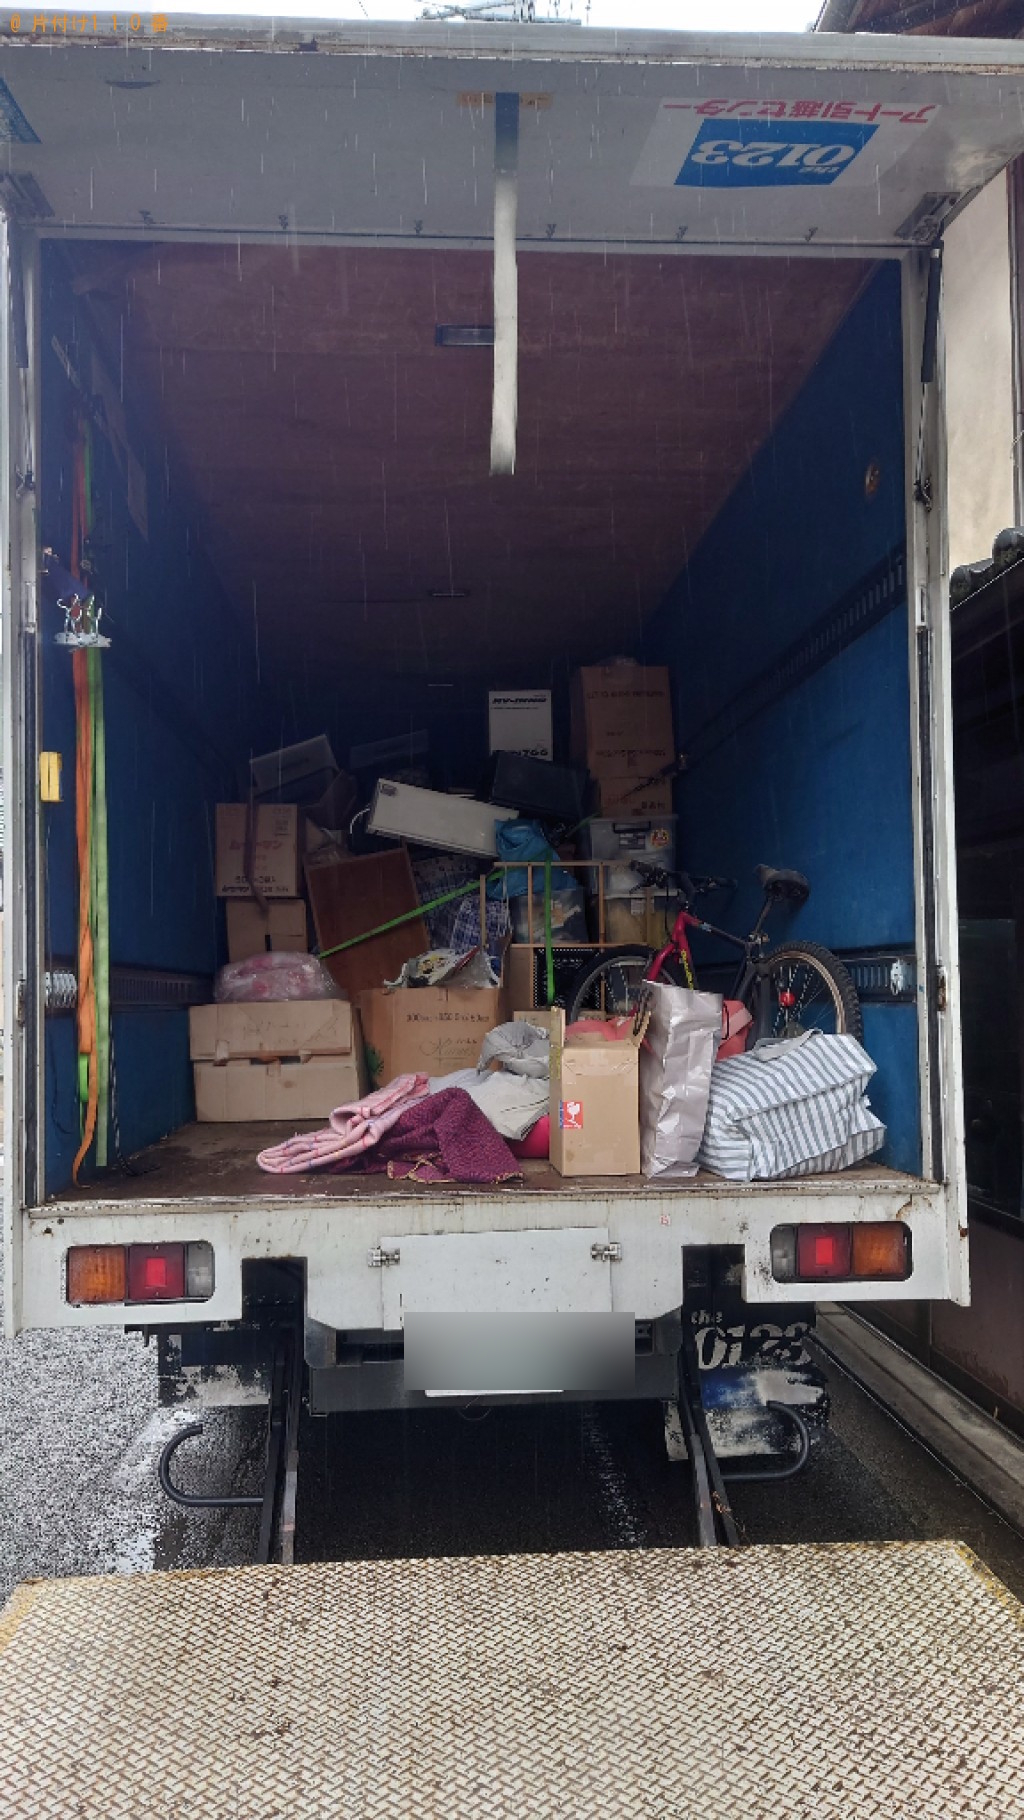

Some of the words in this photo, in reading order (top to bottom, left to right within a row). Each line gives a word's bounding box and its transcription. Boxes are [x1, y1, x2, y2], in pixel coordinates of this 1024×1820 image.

[663, 99, 936, 123] アート引越センター
[691, 139, 856, 167] 0123
